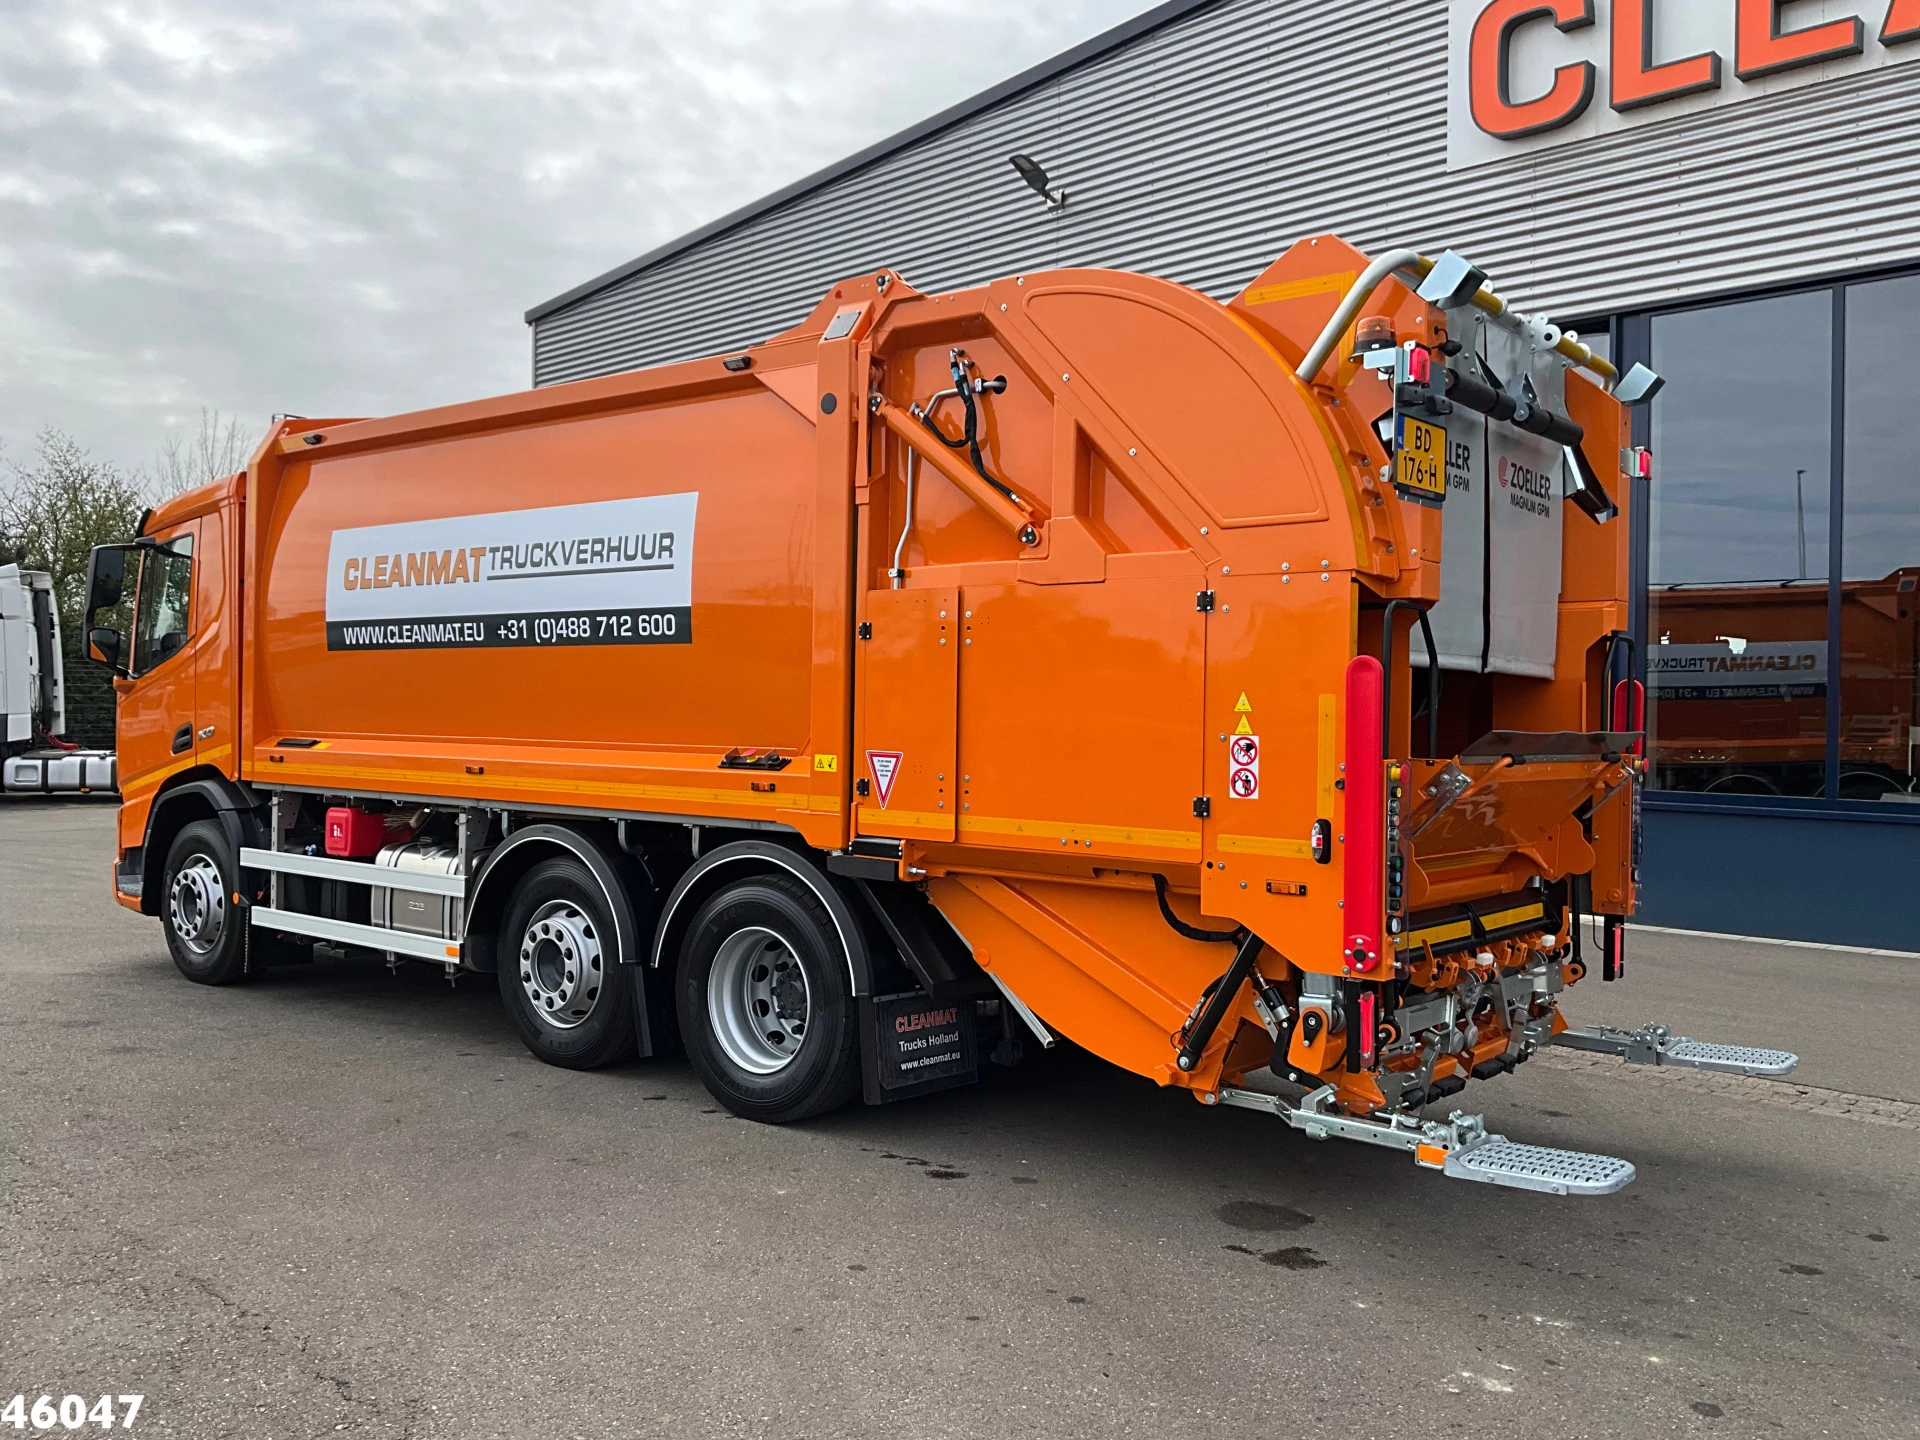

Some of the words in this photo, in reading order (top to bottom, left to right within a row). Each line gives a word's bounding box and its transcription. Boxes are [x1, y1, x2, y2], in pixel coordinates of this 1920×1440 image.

[1468, 0, 1920, 140] CLE
[1415, 425, 1431, 453] BD
[1446, 439, 1470, 473] LER
[1404, 455, 1437, 488] 176-H
[1453, 474, 1470, 493] GPM
[1510, 462, 1551, 501] ZOELLER
[1510, 493, 1537, 514] MAGNUM
[1537, 501, 1550, 518] GPM
[343, 546, 487, 591] CLEANMAT
[488, 531, 675, 571] TRUCKVERHUUR
[343, 622, 484, 645] WWW.CLEANMAT.EU
[497, 618, 528, 640] +31
[534, 616, 591, 644] (0)488
[596, 615, 633, 637] 712
[638, 613, 676, 636] 600
[895, 1008, 958, 1033] CLEANMAT
[899, 1037, 927, 1052] Trucks
[928, 1031, 959, 1047] Holland
[900, 1051, 961, 1071] www.cleanmat.eu
